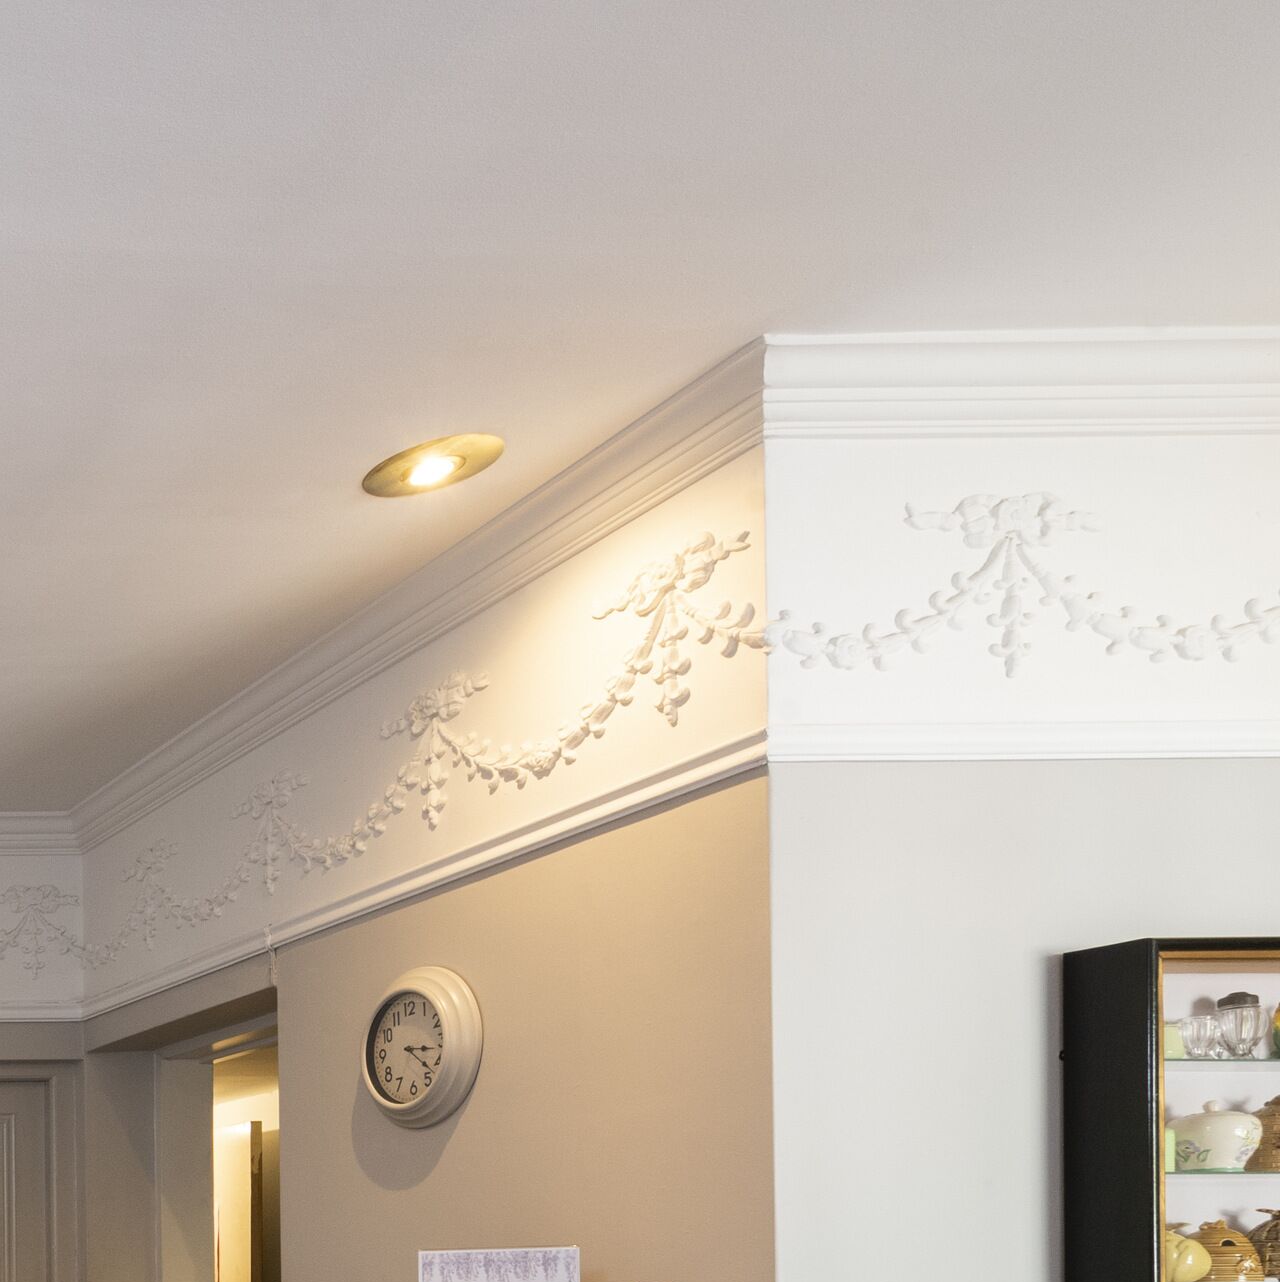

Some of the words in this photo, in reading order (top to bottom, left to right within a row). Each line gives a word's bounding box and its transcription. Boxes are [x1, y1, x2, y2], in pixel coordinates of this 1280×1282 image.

[404, 1001, 415, 1017] 12
[422, 1001, 426, 1016] 1
[392, 1011, 400, 1026] 11
[432, 1013, 441, 1028] 2
[383, 1027, 393, 1044] 10
[379, 1049, 386, 1064] 9
[385, 1066, 392, 1082] 8
[424, 1072, 432, 1087] 5
[396, 1077, 403, 1092] 7
[410, 1080, 417, 1095] 6
